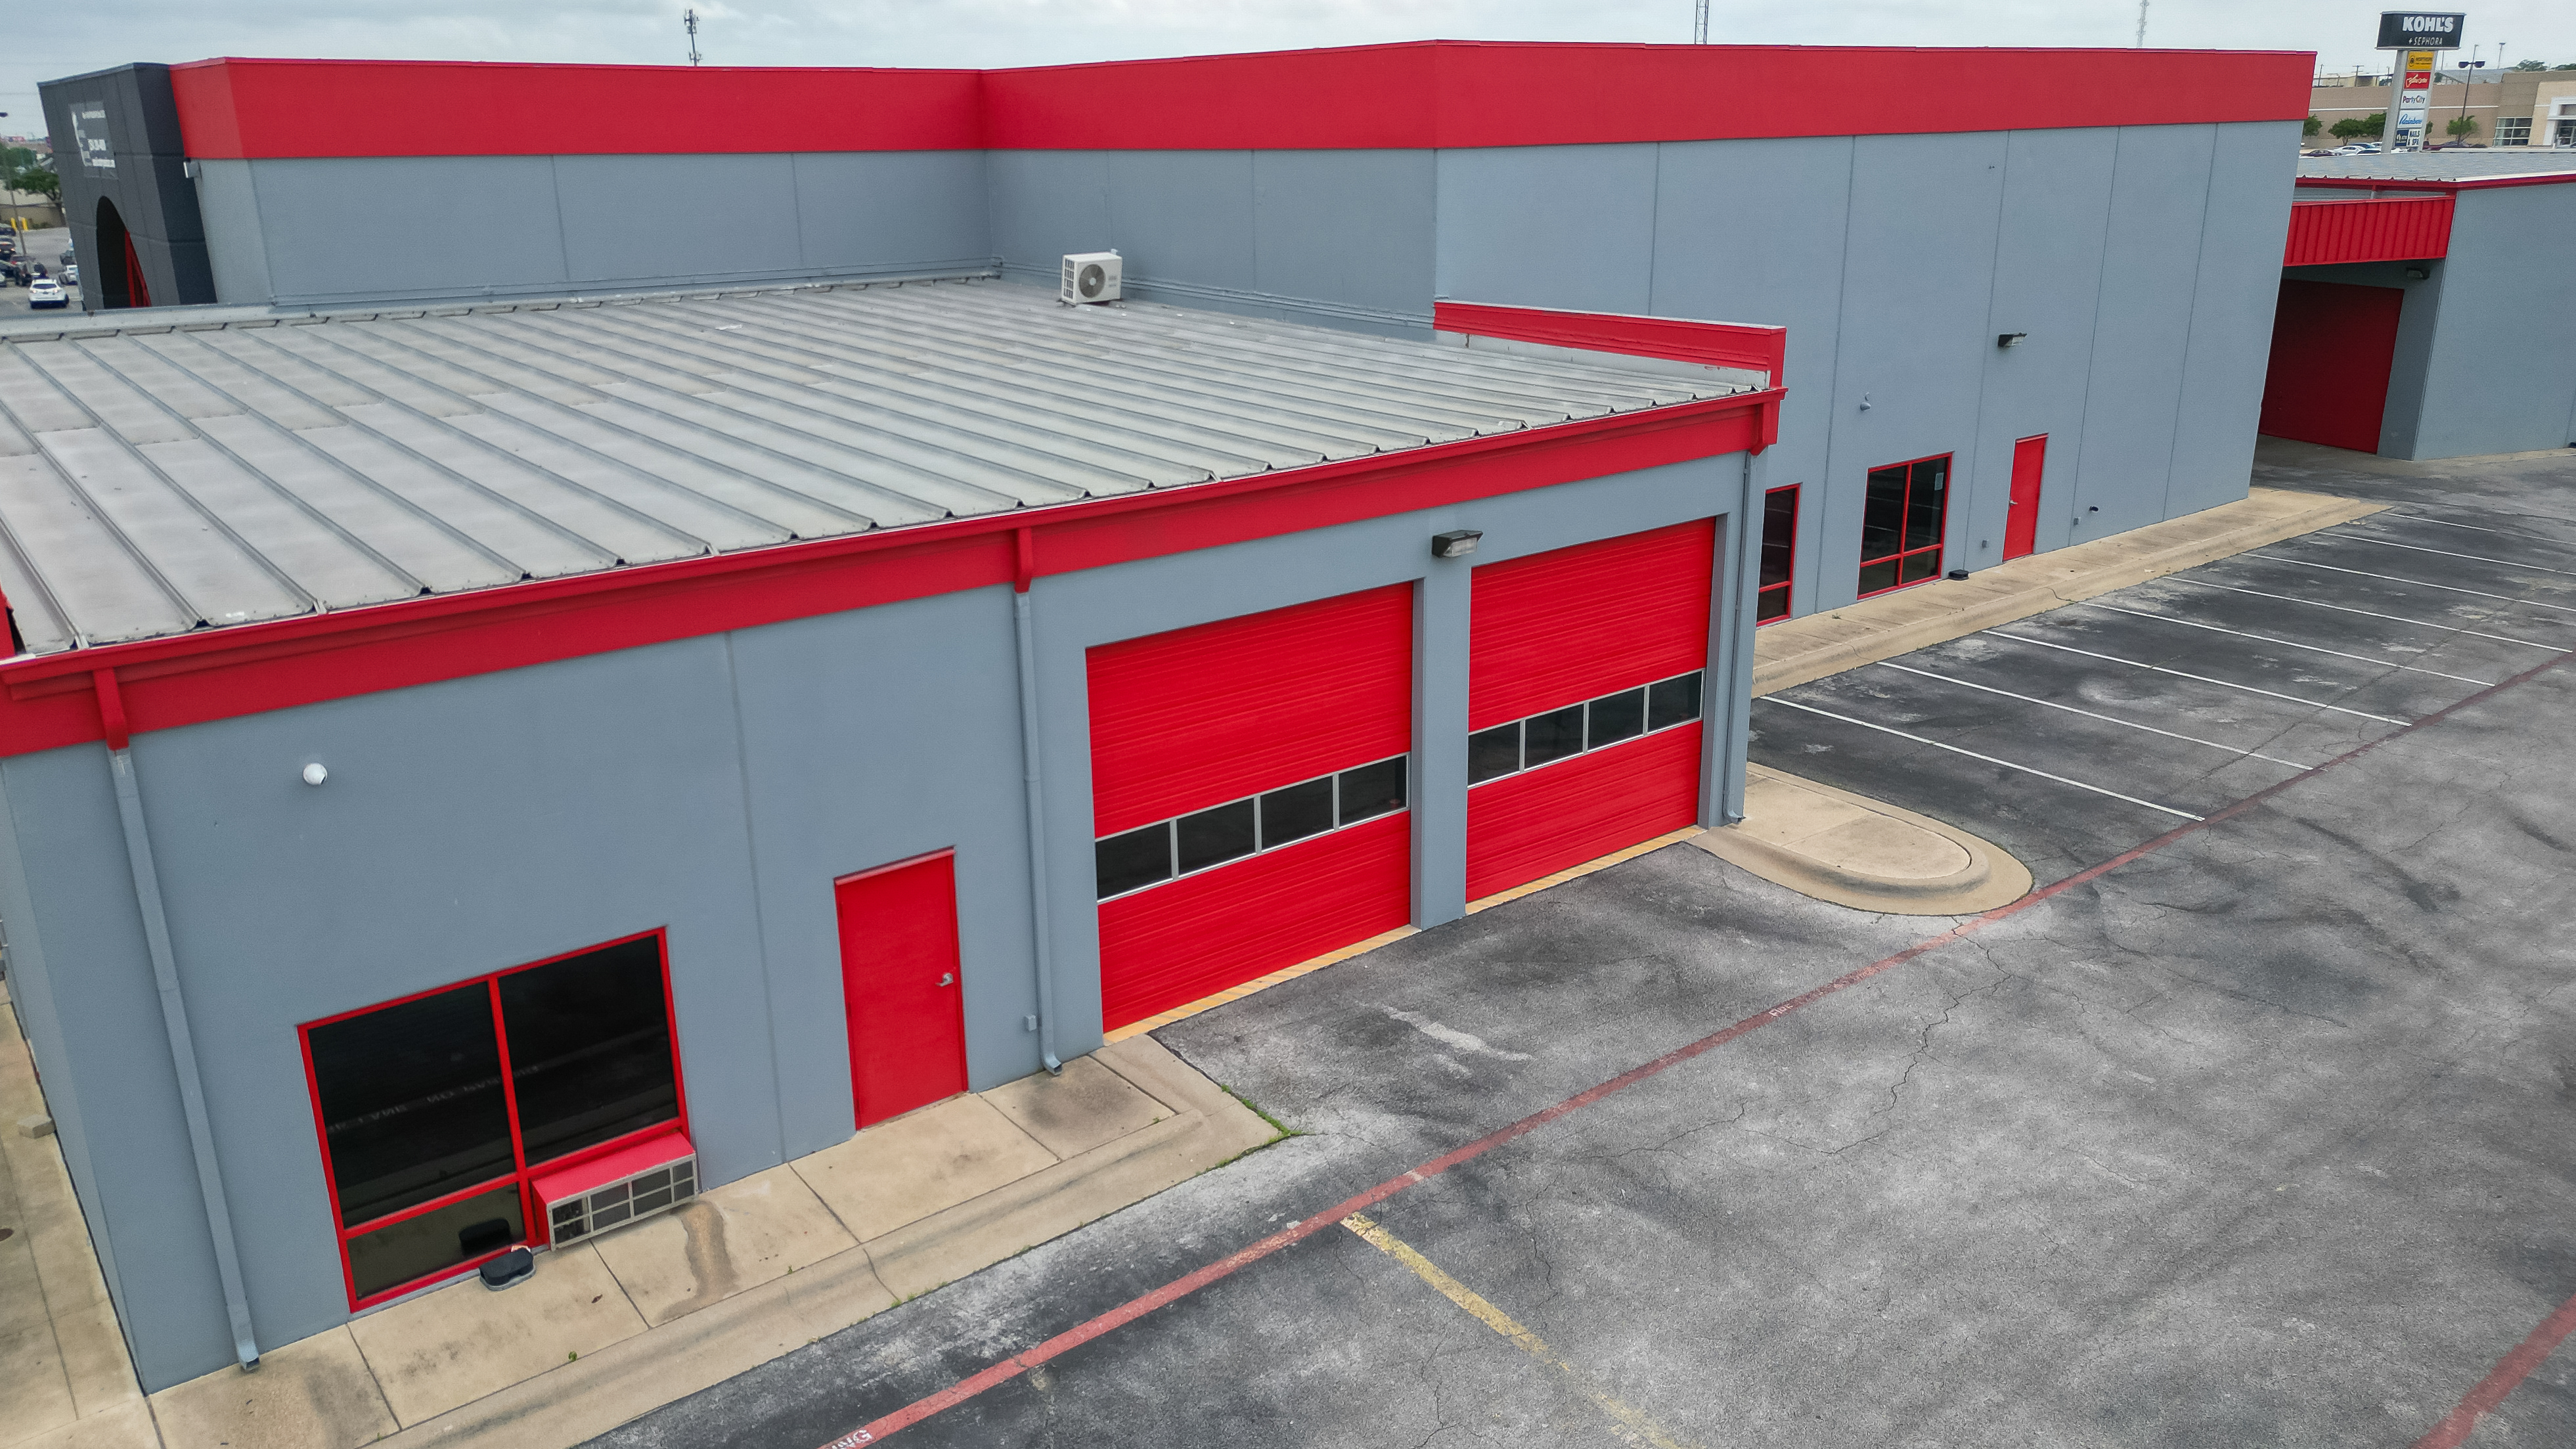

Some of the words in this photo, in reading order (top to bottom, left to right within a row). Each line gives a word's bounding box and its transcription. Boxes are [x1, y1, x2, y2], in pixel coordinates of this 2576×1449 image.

[2402, 16, 2453, 33] KOHL'S
[2414, 36, 2443, 46] SEPHORA
[2403, 95, 2416, 104] Party
